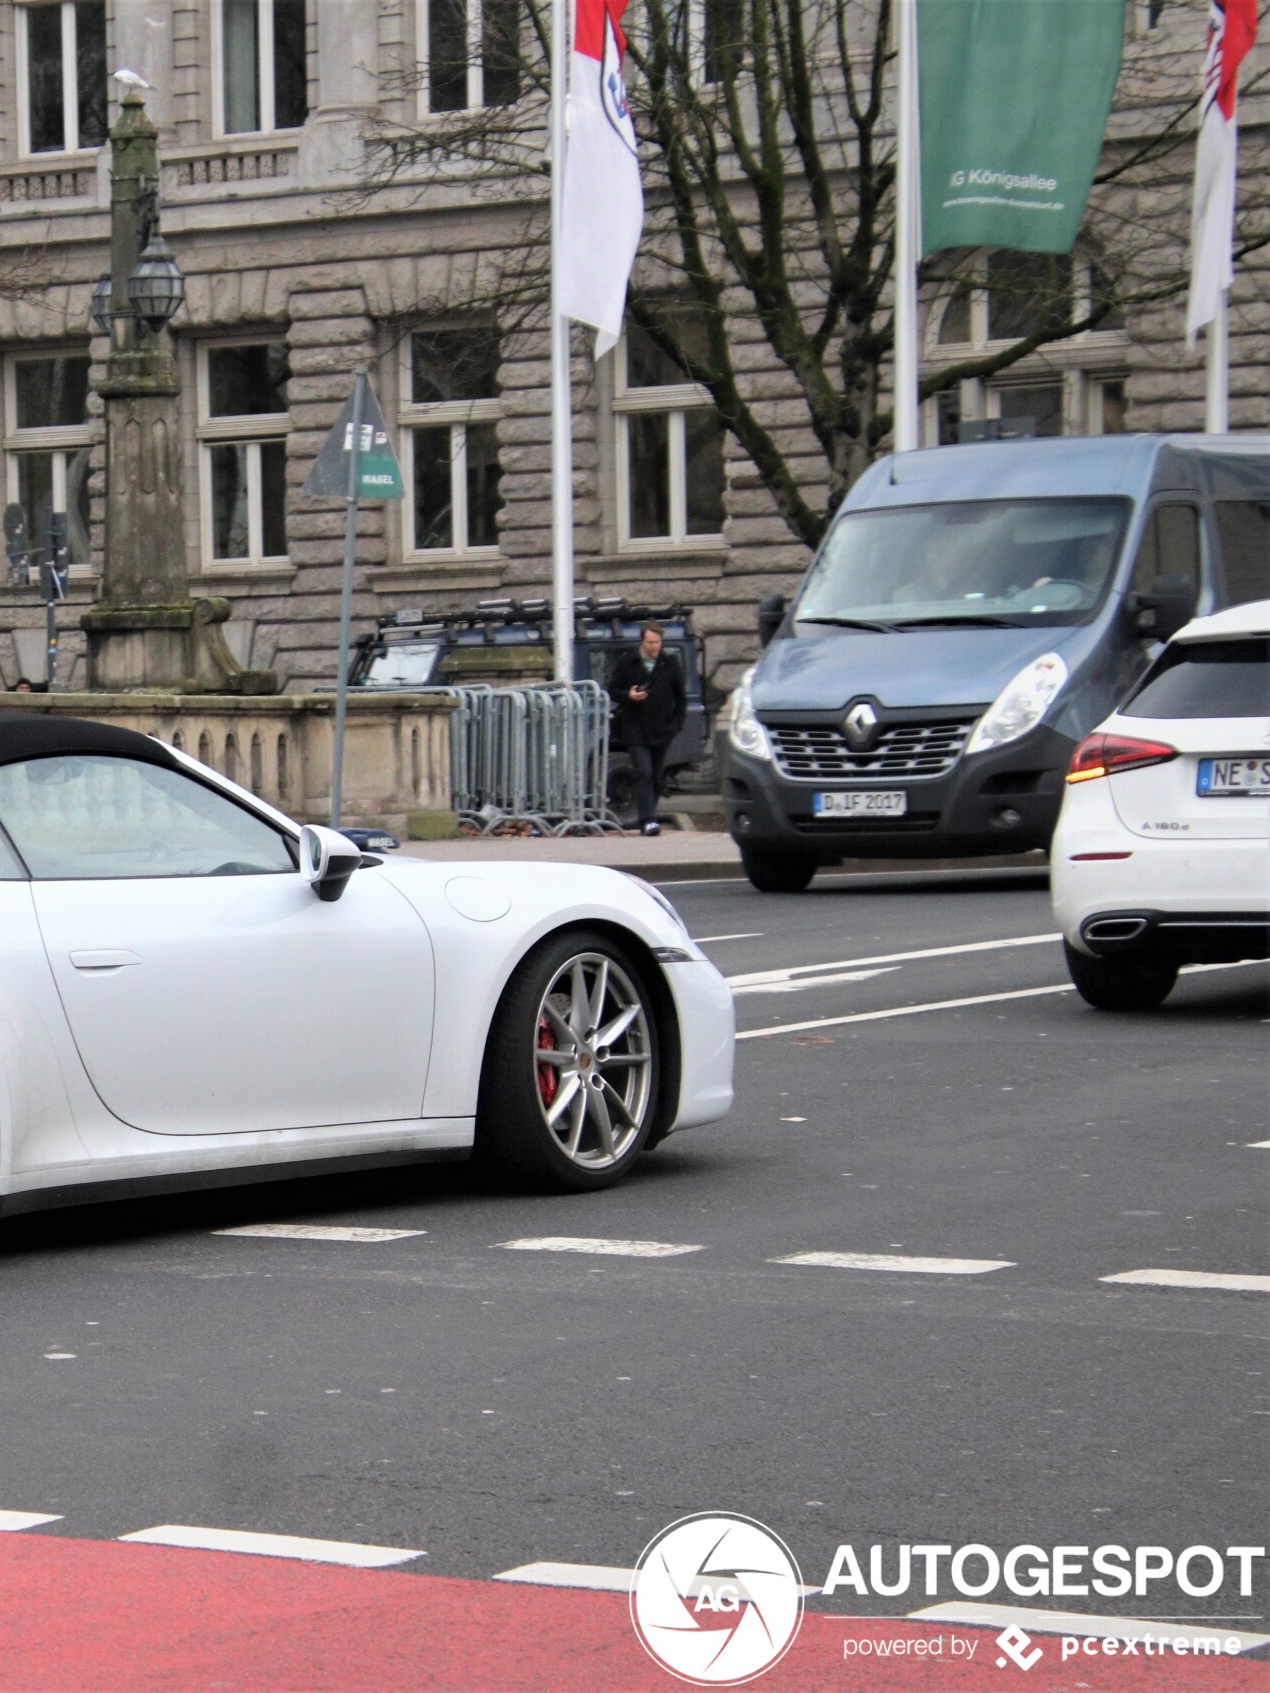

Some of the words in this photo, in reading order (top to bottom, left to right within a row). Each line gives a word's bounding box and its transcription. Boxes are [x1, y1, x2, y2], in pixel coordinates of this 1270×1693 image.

[969, 168, 1058, 190] Königsallee
[1214, 762, 1242, 786] NE
[824, 794, 834, 810] D
[844, 794, 861, 810] IF
[865, 793, 903, 810] 2017
[1142, 822, 1151, 830] A
[1154, 822, 1179, 830] 160
